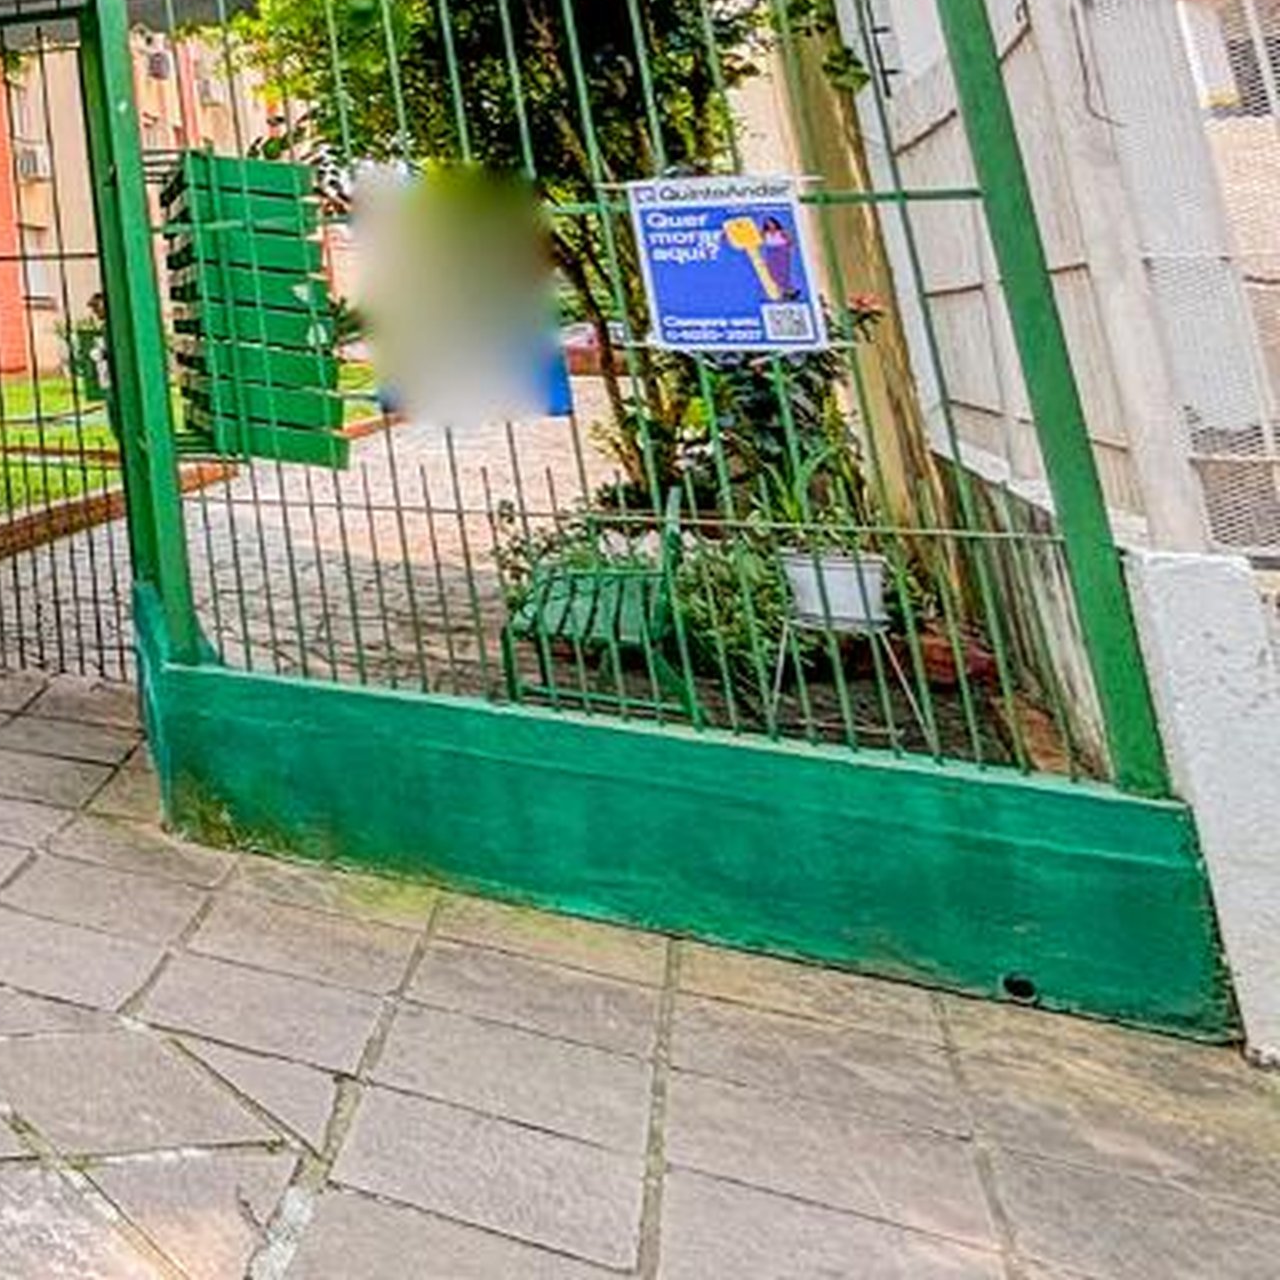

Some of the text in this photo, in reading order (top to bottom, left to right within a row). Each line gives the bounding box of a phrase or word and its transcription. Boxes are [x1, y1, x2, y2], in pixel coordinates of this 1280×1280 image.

[646, 212, 708, 228] Quer
[649, 230, 721, 244] morar
[652, 242, 720, 263] aqui?
